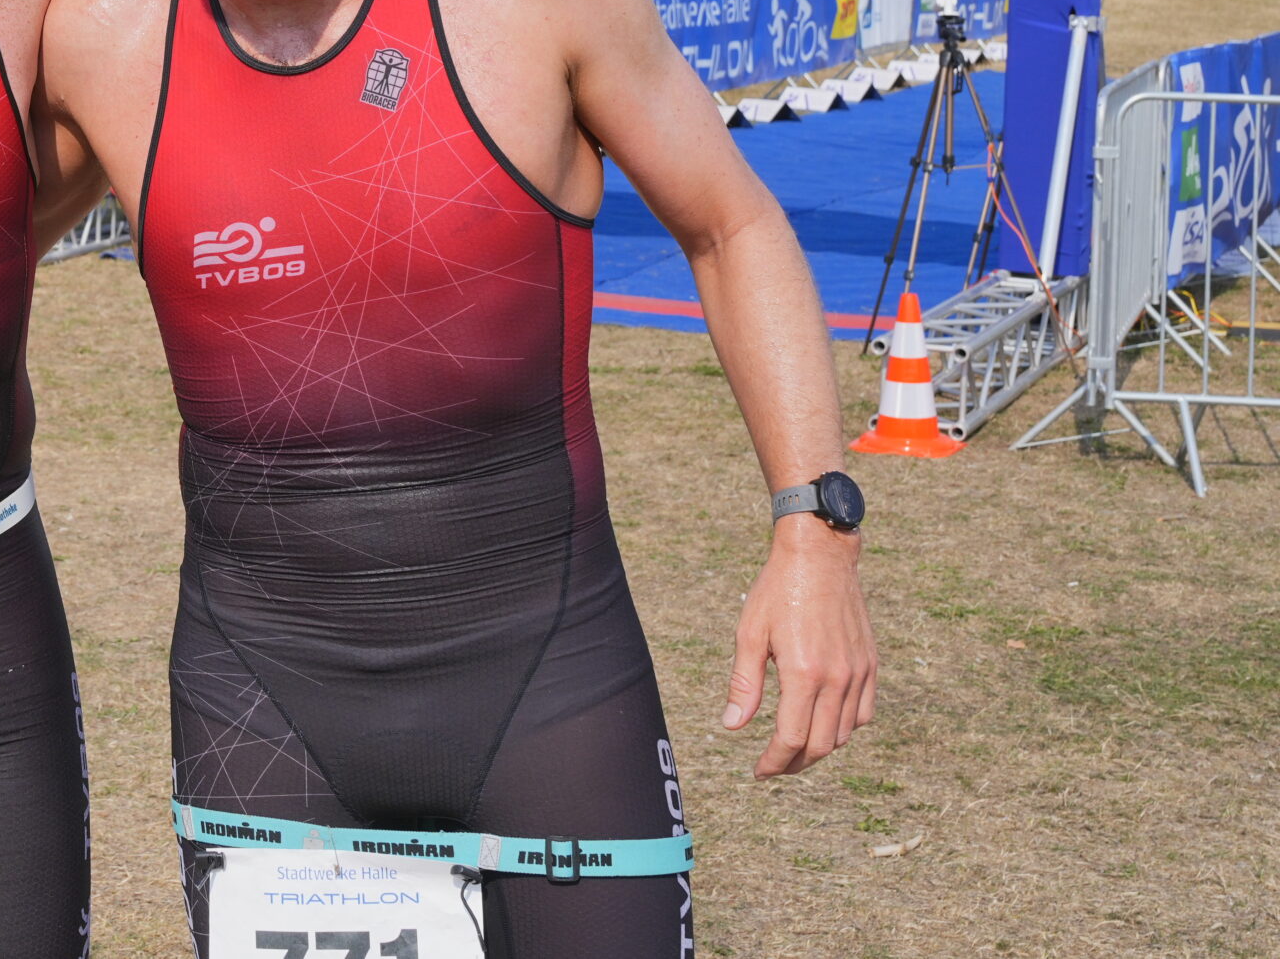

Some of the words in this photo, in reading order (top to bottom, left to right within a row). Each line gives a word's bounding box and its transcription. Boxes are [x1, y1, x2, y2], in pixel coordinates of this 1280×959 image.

[361, 91, 397, 111] BIORACER
[195, 259, 306, 289] TVB09
[200, 821, 282, 844] IRONMAN
[352, 838, 455, 858] IRONMAN
[361, 865, 398, 880] Halle
[264, 891, 420, 906] TRIATHLON
